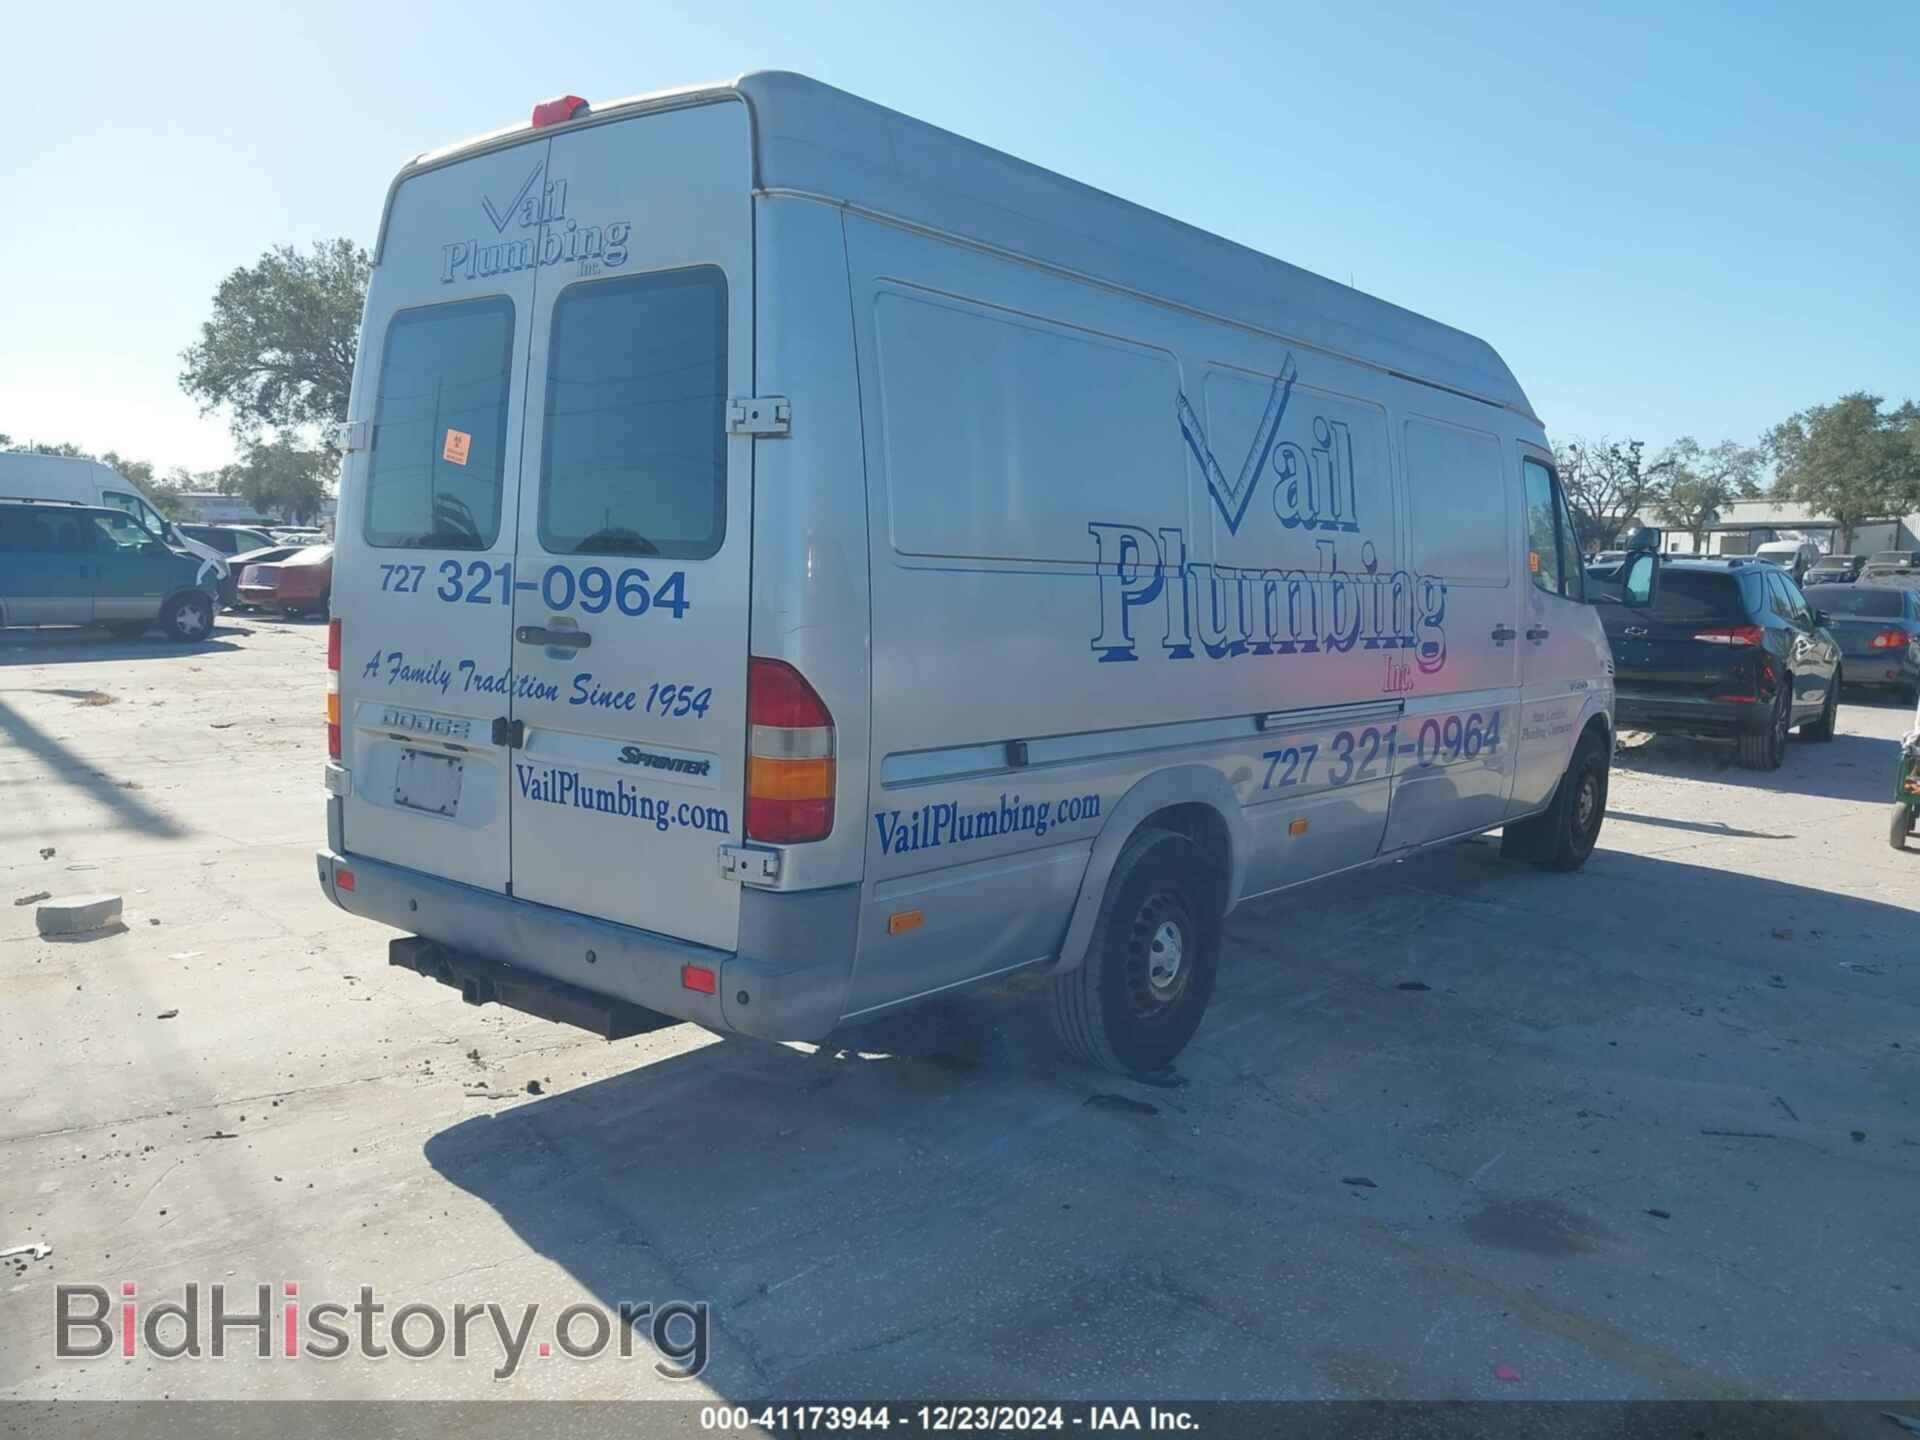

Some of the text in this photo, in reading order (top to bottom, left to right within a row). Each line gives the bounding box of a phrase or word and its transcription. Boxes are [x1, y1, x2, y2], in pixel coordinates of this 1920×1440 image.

[481, 159, 568, 234] Vail
[440, 218, 631, 284] Plumbing
[1176, 351, 1360, 536] Vail
[379, 559, 690, 619] 727 321-0964
[1089, 521, 1447, 674] Plumbing
[362, 650, 713, 719] A Family Tradition Since 1954
[1382, 655, 1414, 693] Inc.
[1261, 710, 1501, 790] 727 321-0964
[515, 763, 731, 832] VailPlumbing.com
[873, 793, 1102, 857] VailPlumbing.com
